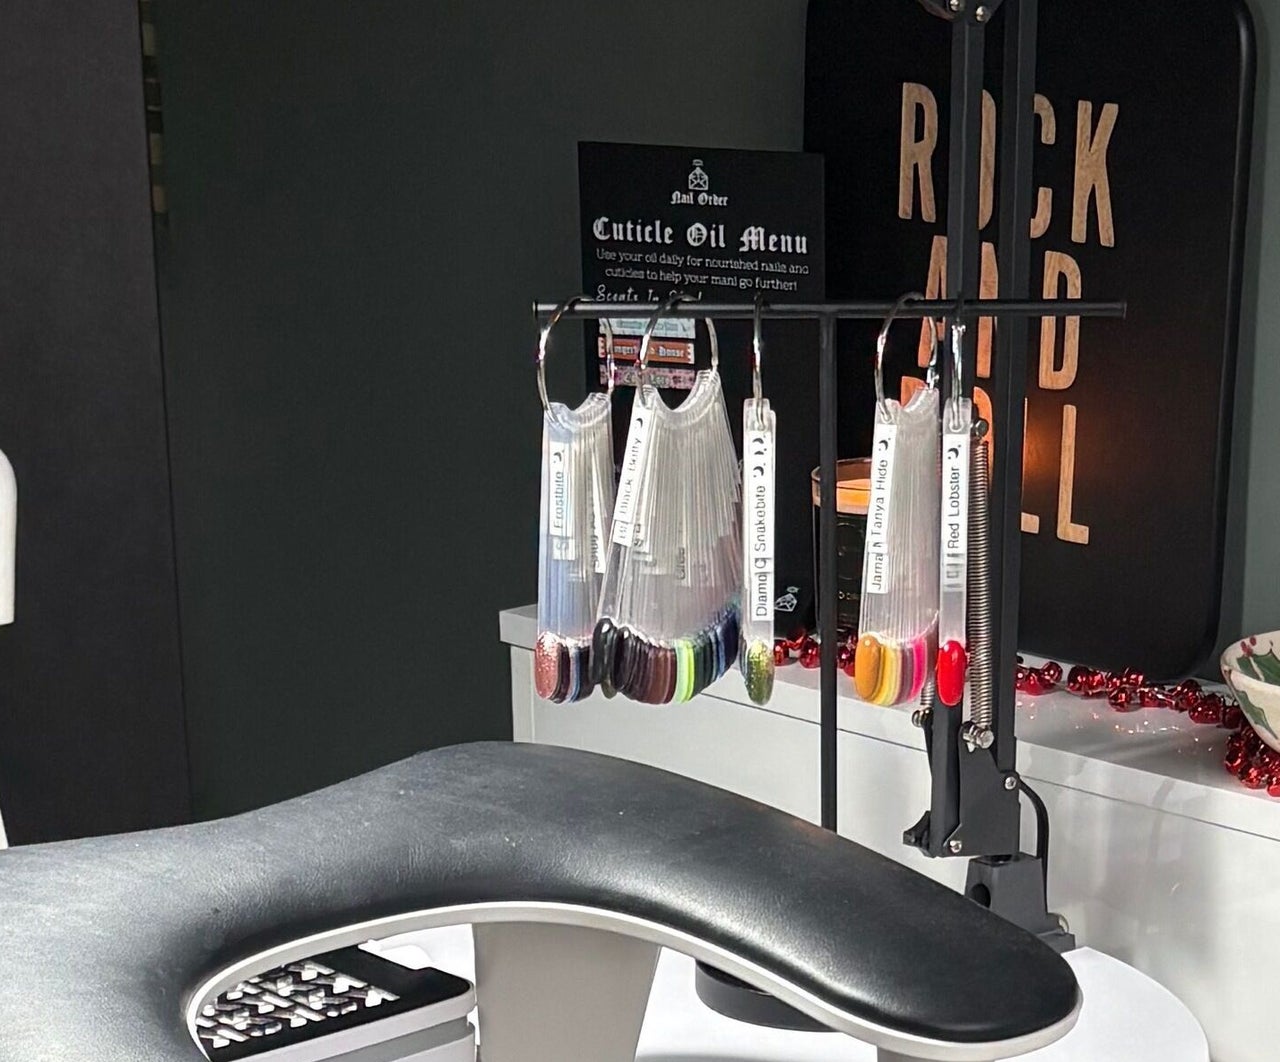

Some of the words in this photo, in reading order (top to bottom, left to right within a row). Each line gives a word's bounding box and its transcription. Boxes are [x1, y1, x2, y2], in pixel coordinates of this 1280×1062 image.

[592, 216, 674, 244] Cuticle
[686, 222, 726, 248] Oil
[739, 226, 808, 254] Menu
[618, 251, 644, 264] your
[645, 252, 657, 264] oil
[659, 253, 685, 267] daily
[686, 255, 703, 266] for
[705, 258, 759, 271] nourished
[761, 261, 787, 274] nails
[788, 263, 810, 275] and
[646, 269, 658, 280] to
[659, 269, 682, 284] help
[683, 273, 709, 286] your
[710, 275, 737, 287] mani
[739, 278, 753, 290] go
[877, 459, 888, 491] Hide
[949, 466, 960, 517] Lobster
[554, 471, 565, 529] Frostbite
[754, 485, 766, 552] Snakebite
[871, 497, 885, 535] Tanya
[948, 523, 960, 548] Red
